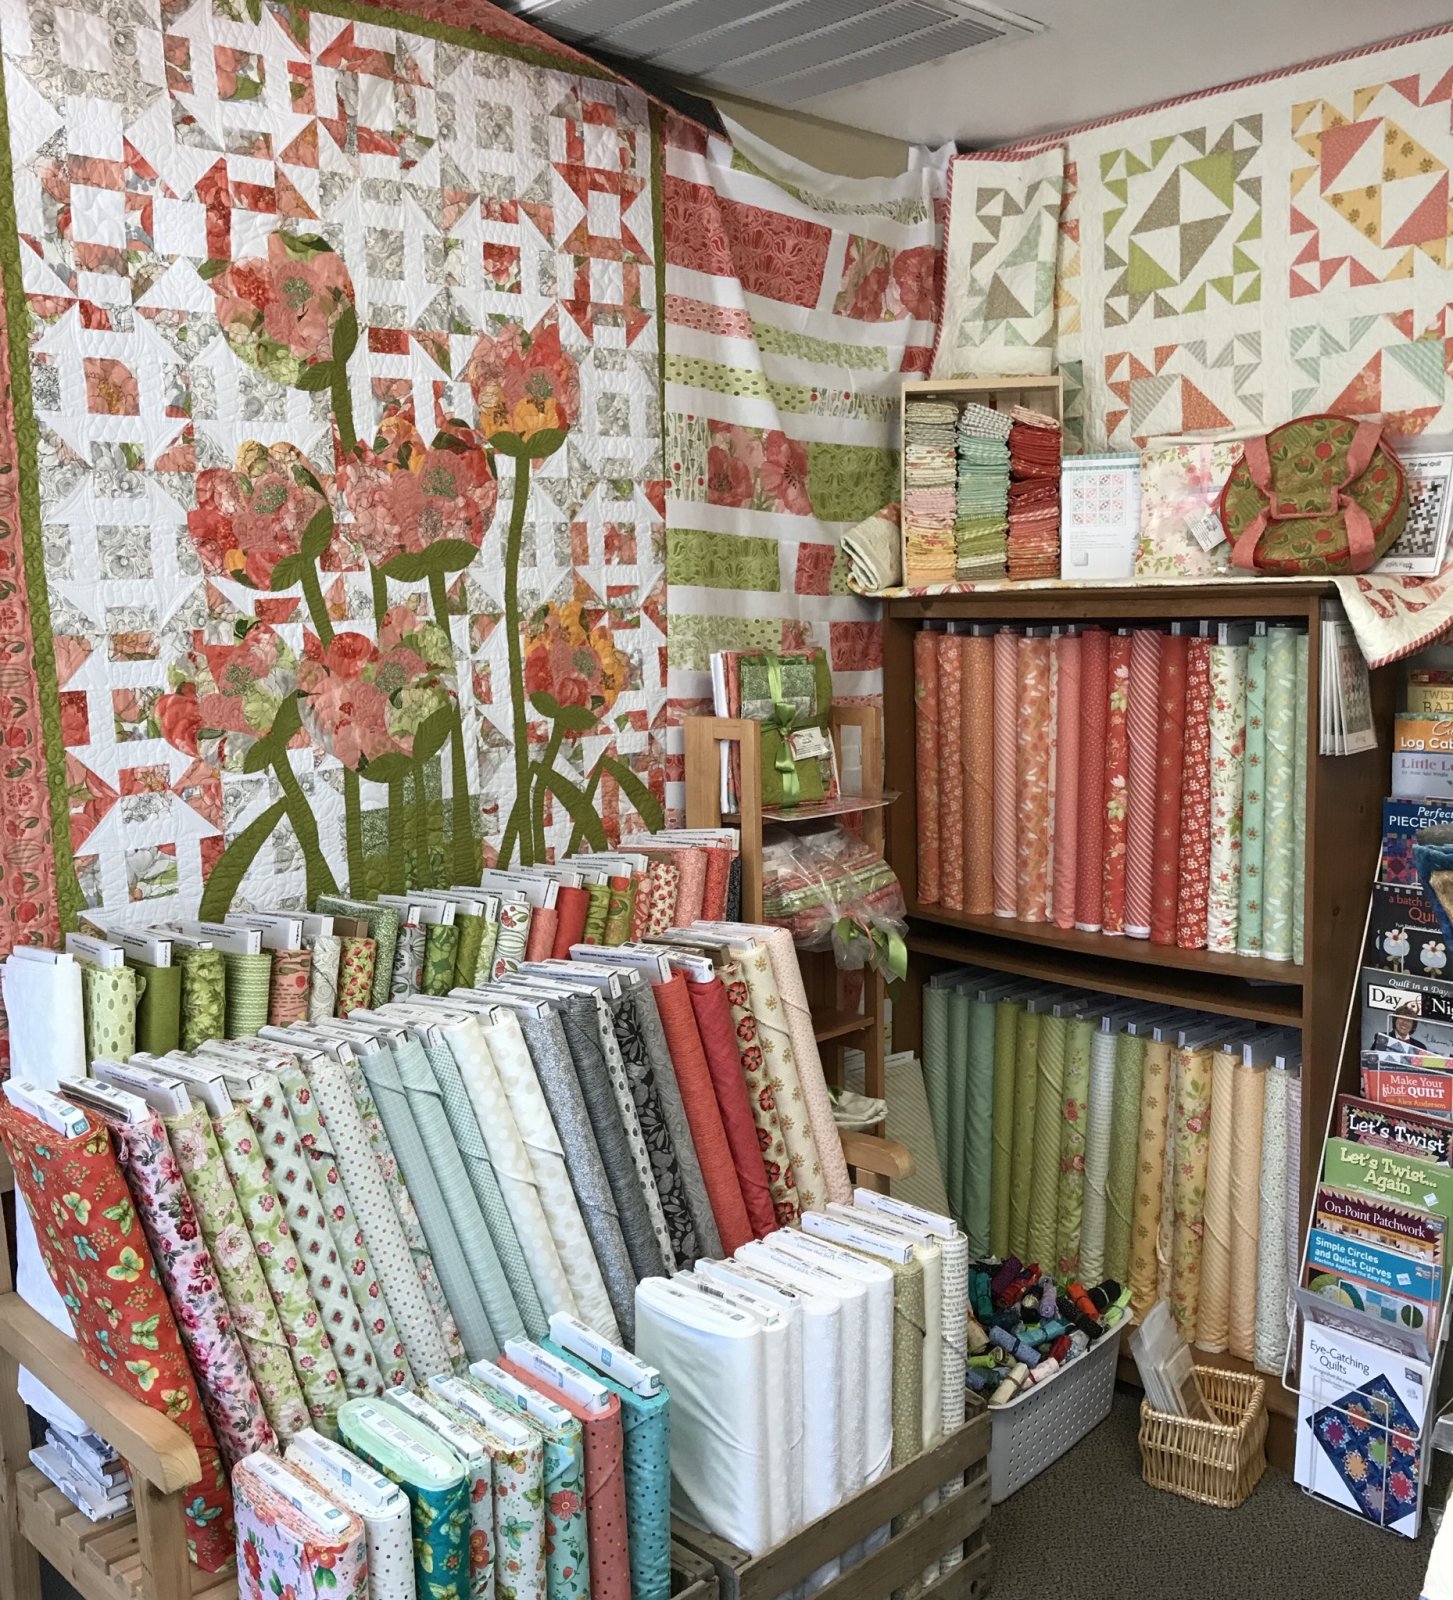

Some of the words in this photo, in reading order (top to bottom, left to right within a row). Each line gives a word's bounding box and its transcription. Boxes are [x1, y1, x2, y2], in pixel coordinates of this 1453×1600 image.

[1401, 736, 1425, 750] Log
[1401, 759, 1436, 769] Little
[1396, 894, 1423, 907] batch
[1388, 978, 1410, 988] Quilt
[1412, 982, 1420, 990] in
[1431, 985, 1449, 998] Day
[1372, 988, 1401, 1009] Day
[1382, 1083, 1408, 1098] first
[1407, 1086, 1445, 1099] QUILT
[1390, 1074, 1418, 1086] Make
[1420, 1077, 1444, 1088] Your
[1413, 1099, 1447, 1109] Anderson
[74, 1121, 86, 1132] QT
[1349, 1114, 1390, 1138] Let's
[1394, 1126, 1445, 1154] Twist
[1340, 1147, 1379, 1170] Let's
[1363, 1169, 1411, 1195] Again
[1324, 1200, 1370, 1222] On-Point
[1373, 1213, 1426, 1239] Patchwork
[1315, 1237, 1346, 1254] Simple
[1347, 1247, 1379, 1264] Circles
[1314, 1248, 1331, 1260] and
[1333, 1252, 1357, 1268] Quick
[1359, 1261, 1392, 1279] Curves
[1310, 1339, 1370, 1376] Eye-Catching
[1319, 1355, 1347, 1375] Quilts
